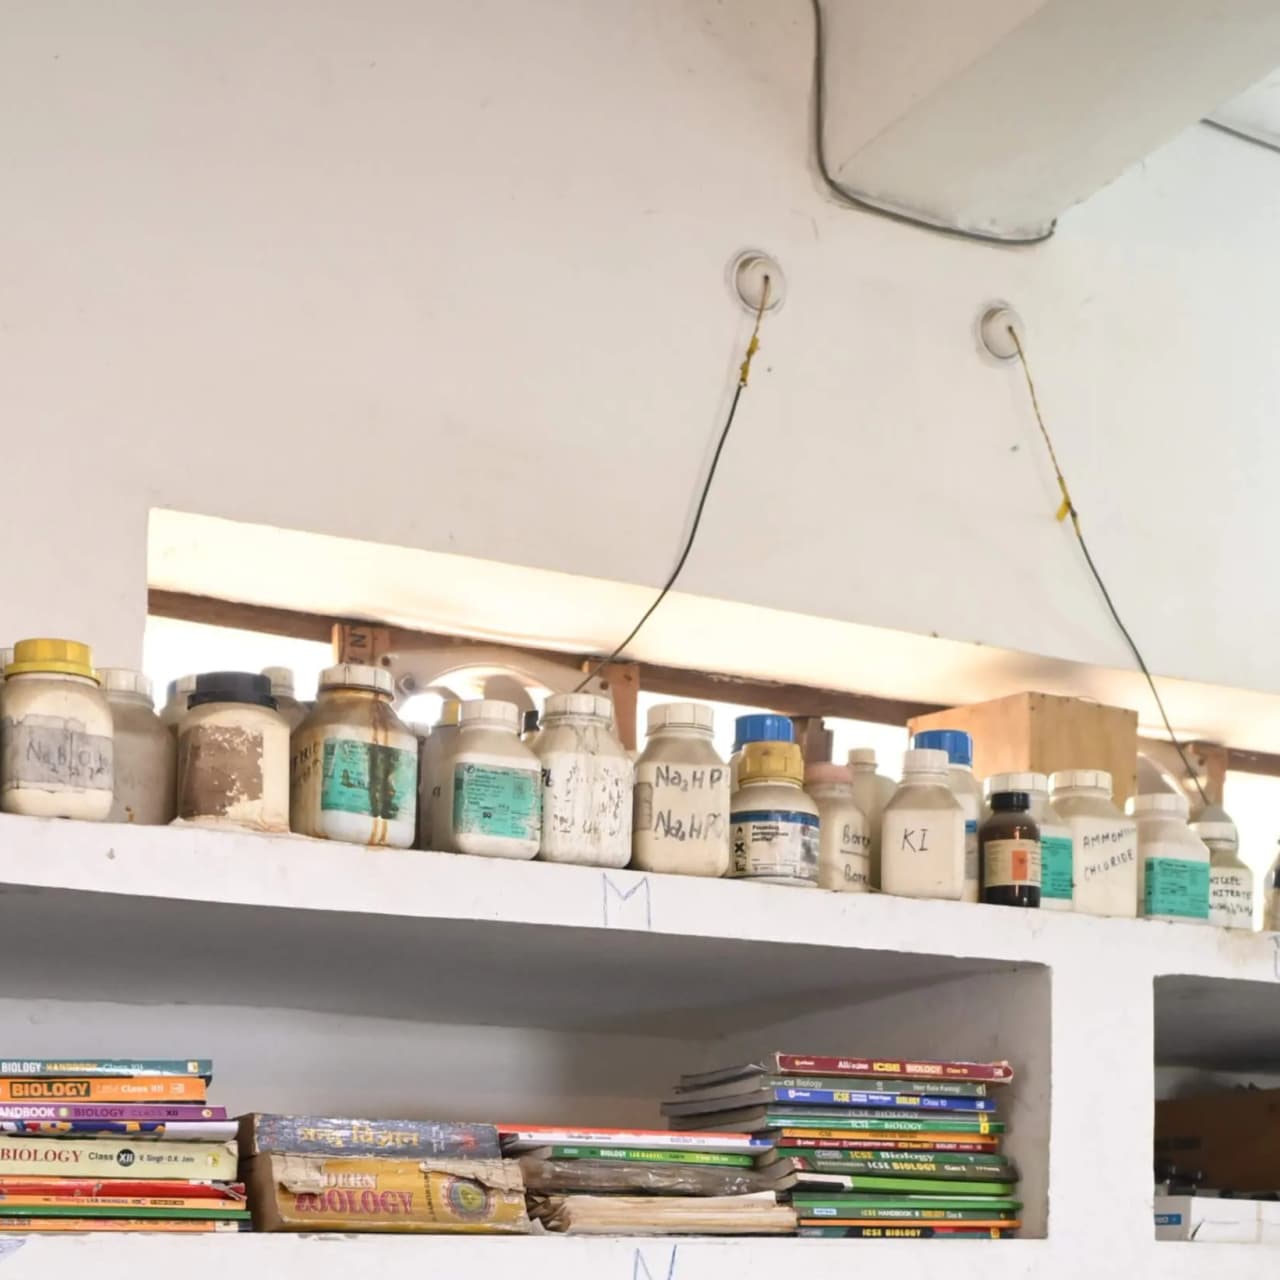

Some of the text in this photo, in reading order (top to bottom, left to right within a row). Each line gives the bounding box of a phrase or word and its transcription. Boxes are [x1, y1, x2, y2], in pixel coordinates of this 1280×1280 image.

[902, 827, 929, 852] KI
[603, 872, 651, 928] M
[1, 1062, 42, 1073] BIOLOGY
[11, 1082, 89, 1097] BIOLOGY
[121, 1084, 148, 1093] Class
[74, 1109, 125, 1118] BIOLOGY
[884, 1122, 923, 1130] BIOLOGY
[0, 1148, 83, 1163] BIOLOGY
[88, 1151, 115, 1161] Class
[880, 1151, 935, 1162] Biology
[891, 1162, 936, 1171] BIOLOGY
